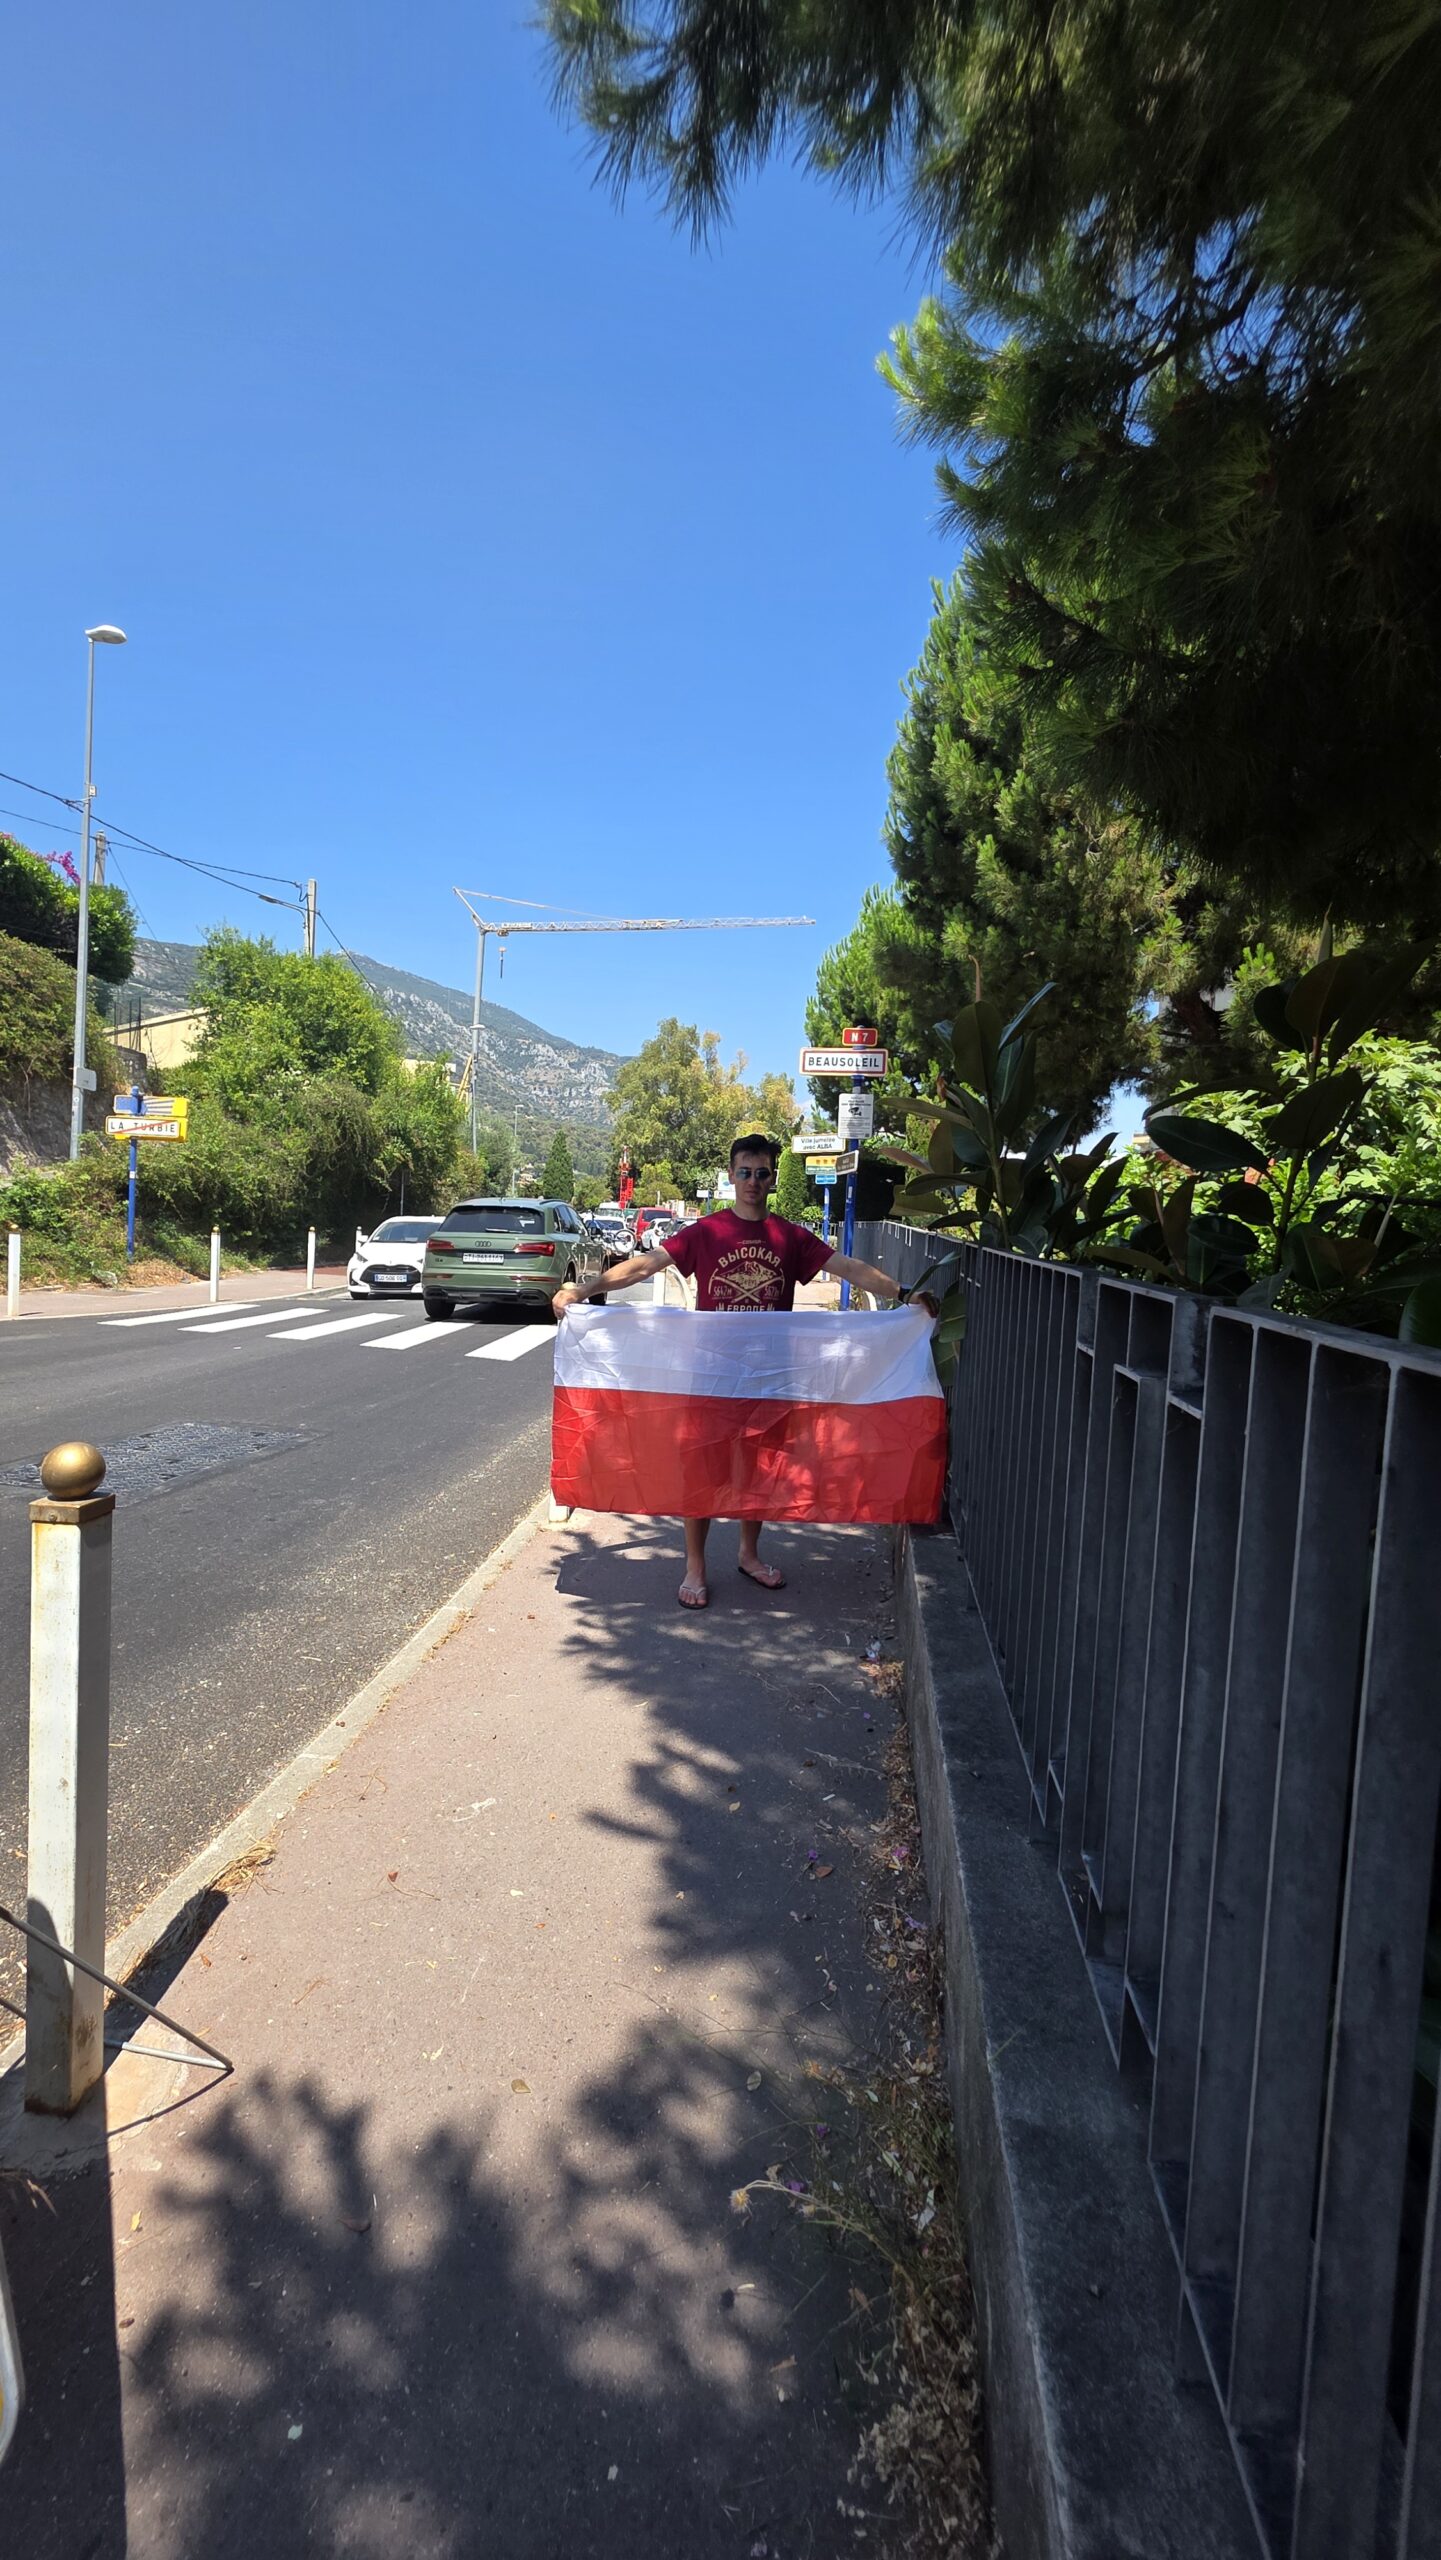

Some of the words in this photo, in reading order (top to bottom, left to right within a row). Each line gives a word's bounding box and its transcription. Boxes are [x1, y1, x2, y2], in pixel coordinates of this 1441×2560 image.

[851, 1033, 860, 1042] N
[863, 1033, 869, 1042] 7
[808, 1057, 880, 1068] BEAUSOLEIL
[110, 1122, 124, 1130] LA
[134, 1122, 176, 1133] TURBIE
[718, 1246, 781, 1267] ВЫСОКАЯ
